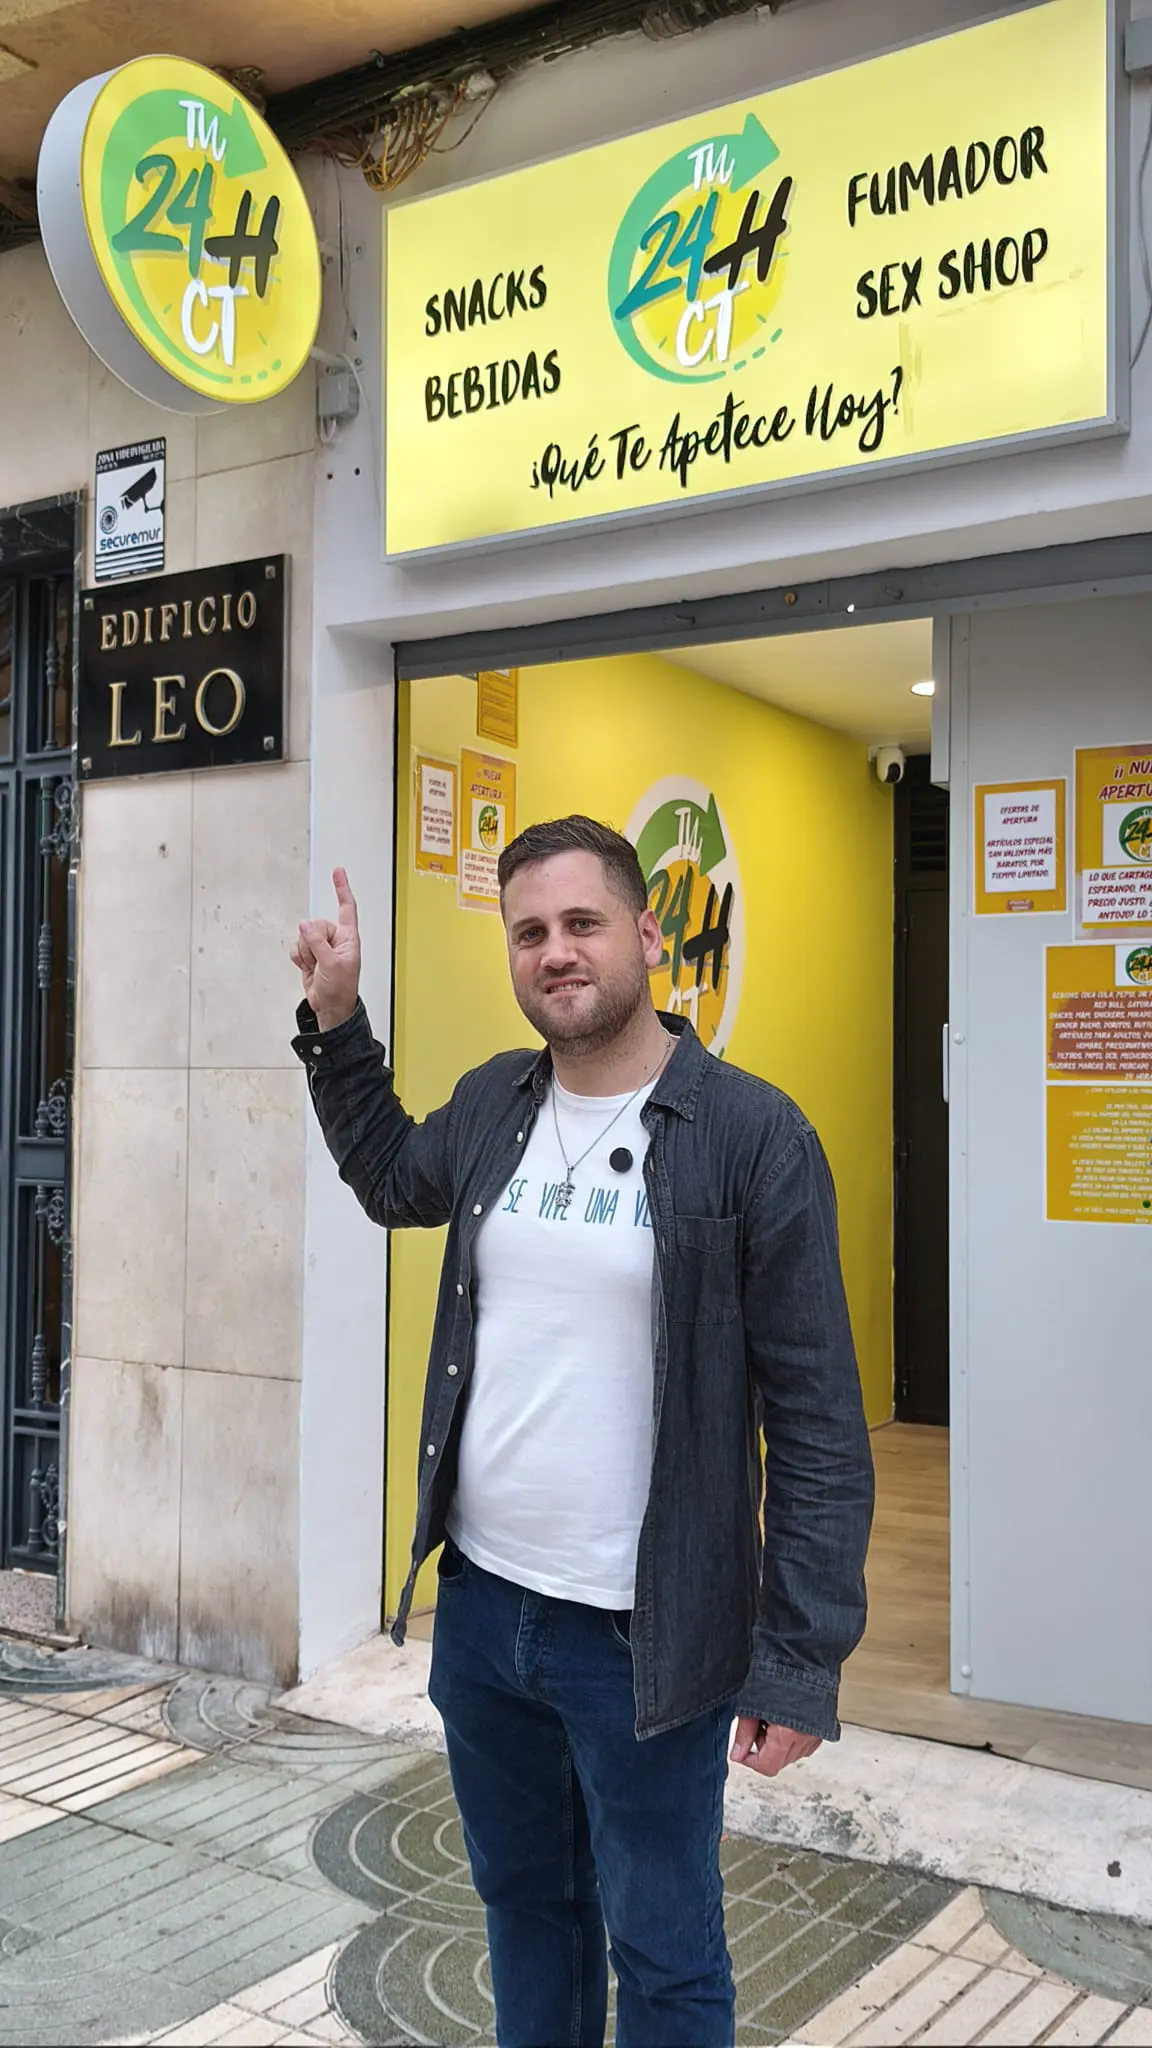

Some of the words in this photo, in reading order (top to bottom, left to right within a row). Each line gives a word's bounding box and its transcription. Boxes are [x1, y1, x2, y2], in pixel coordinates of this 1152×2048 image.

[178, 99, 227, 163] TU
[687, 142, 736, 191] TU
[847, 125, 1048, 228] FUMADOR
[425, 264, 548, 338] SNACKS
[856, 256, 923, 319] SEX
[938, 227, 1048, 301] SHOP
[181, 279, 249, 367] CT
[675, 280, 752, 368] CT
[424, 348, 562, 423] BEBIDAS
[529, 433, 606, 499] ¡Qué
[608, 423, 653, 481] Te
[659, 391, 796, 488] Apetece
[100, 527, 162, 550] securemur
[101, 591, 257, 650] EDIFICIO
[107, 667, 247, 747] LEO
[1002, 815, 1038, 825] APERTURA
[988, 849, 1002, 858] SAN
[992, 870, 1017, 879] TIEMPO
[1030, 859, 1045, 867] POR
[1089, 872, 1100, 882] LO
[1101, 871, 1117, 881] QUE
[1087, 898, 1116, 908] PRECIO
[503, 1179, 528, 1213] SE
[584, 1187, 619, 1225] UNA
